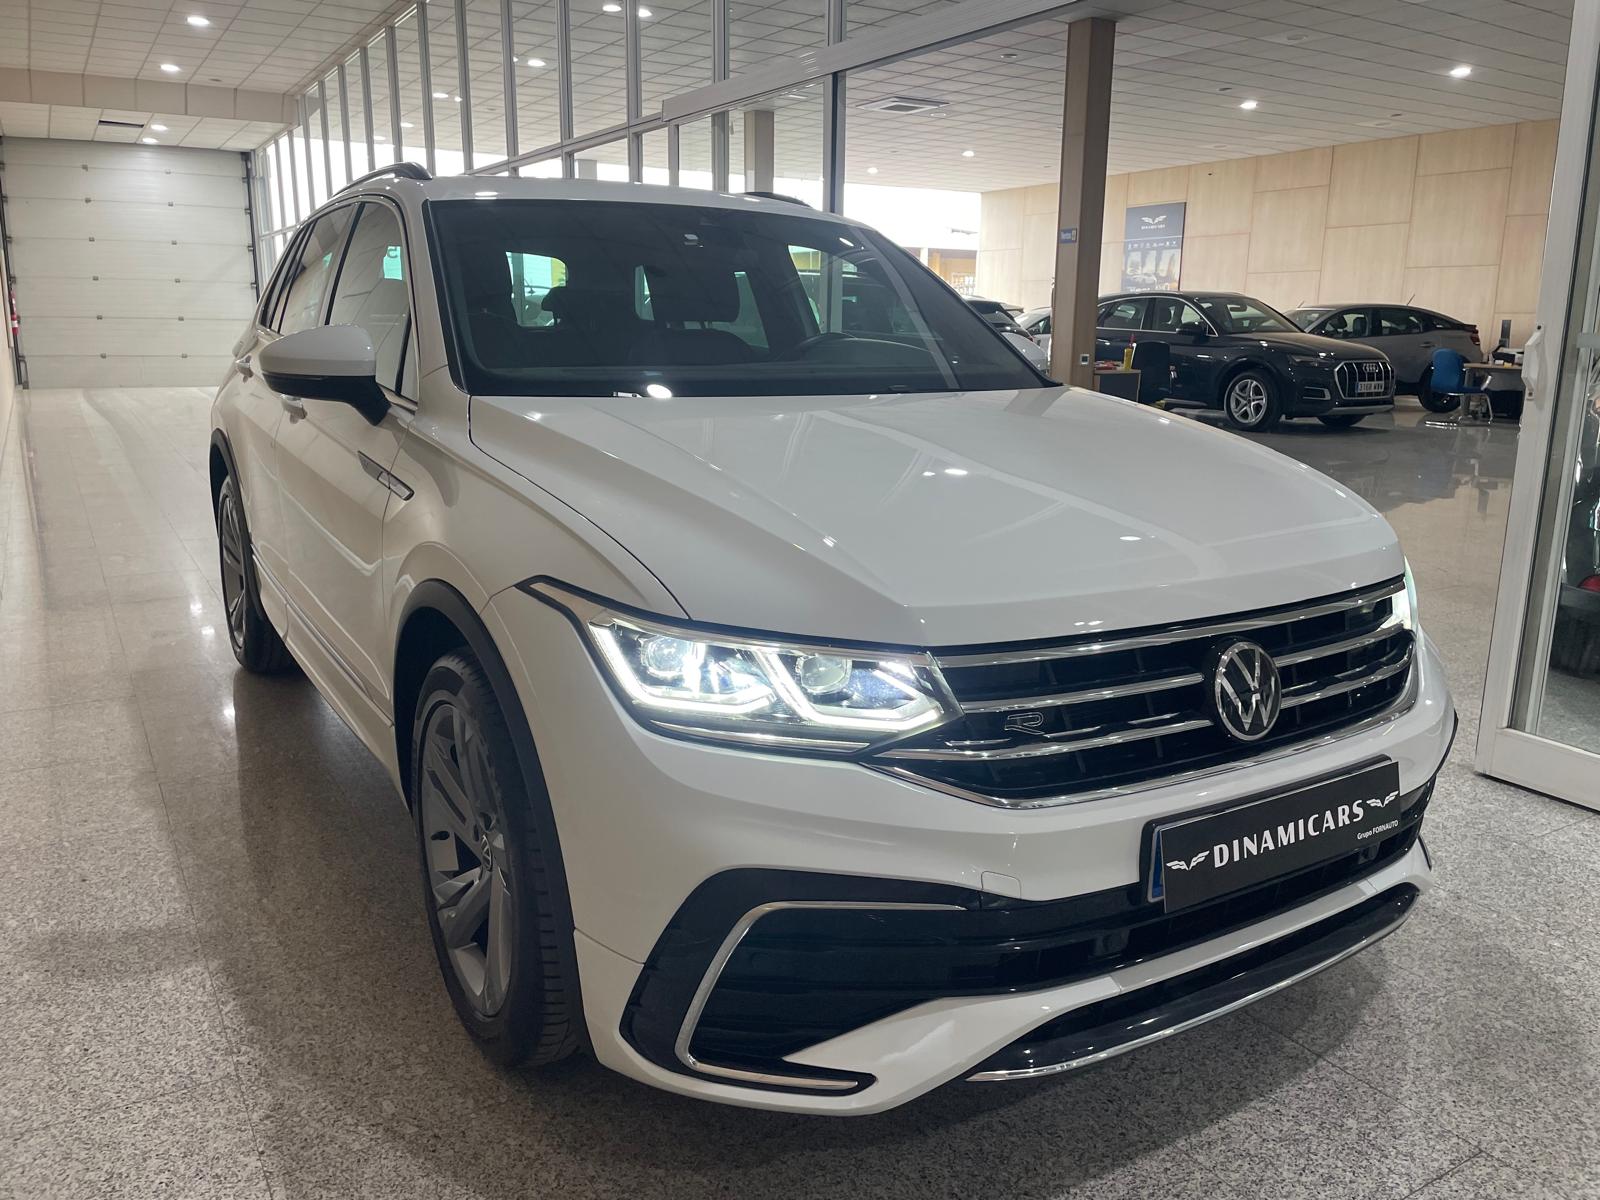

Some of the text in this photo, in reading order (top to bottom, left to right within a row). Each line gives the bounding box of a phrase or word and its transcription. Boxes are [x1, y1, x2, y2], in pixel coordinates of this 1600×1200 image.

[1213, 799, 1364, 868] DINAMICARS
[1356, 819, 1399, 840] Grupo FORNAUTO
